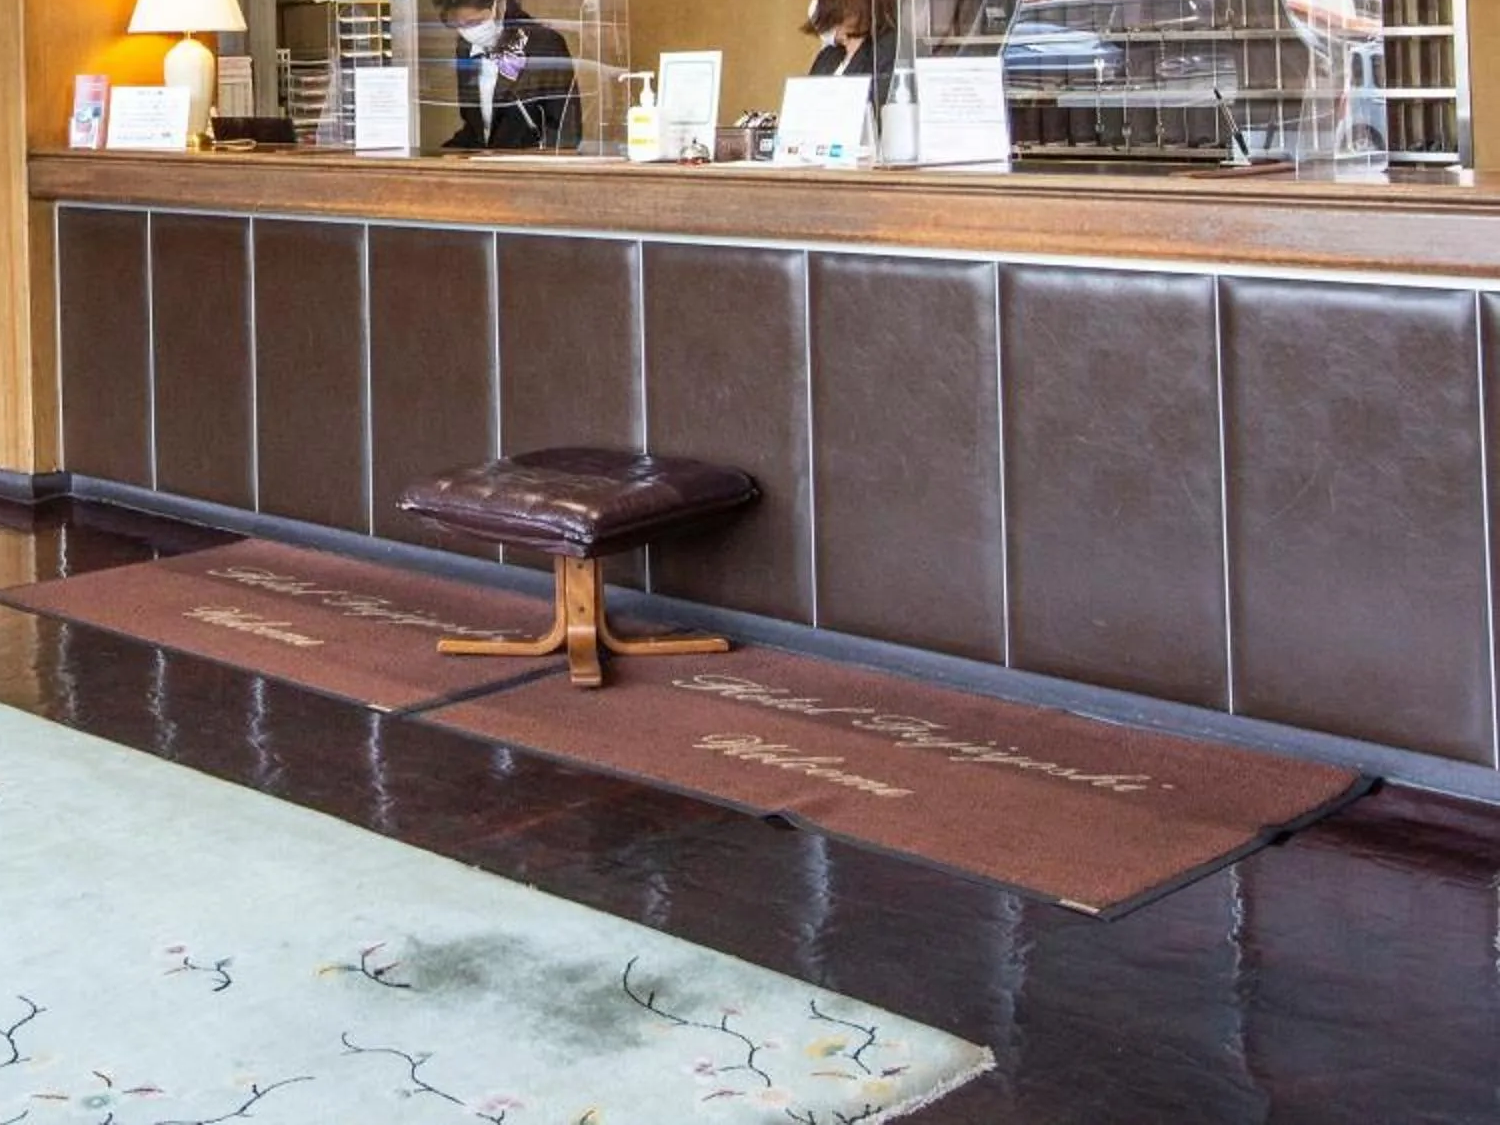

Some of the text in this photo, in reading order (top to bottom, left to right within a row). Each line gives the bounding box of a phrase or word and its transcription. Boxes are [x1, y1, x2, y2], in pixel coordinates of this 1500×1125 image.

[206, 567, 346, 595] Hotel
[182, 607, 325, 647] Welcome
[672, 675, 875, 715] Hotel
[693, 734, 916, 796] Welcome
